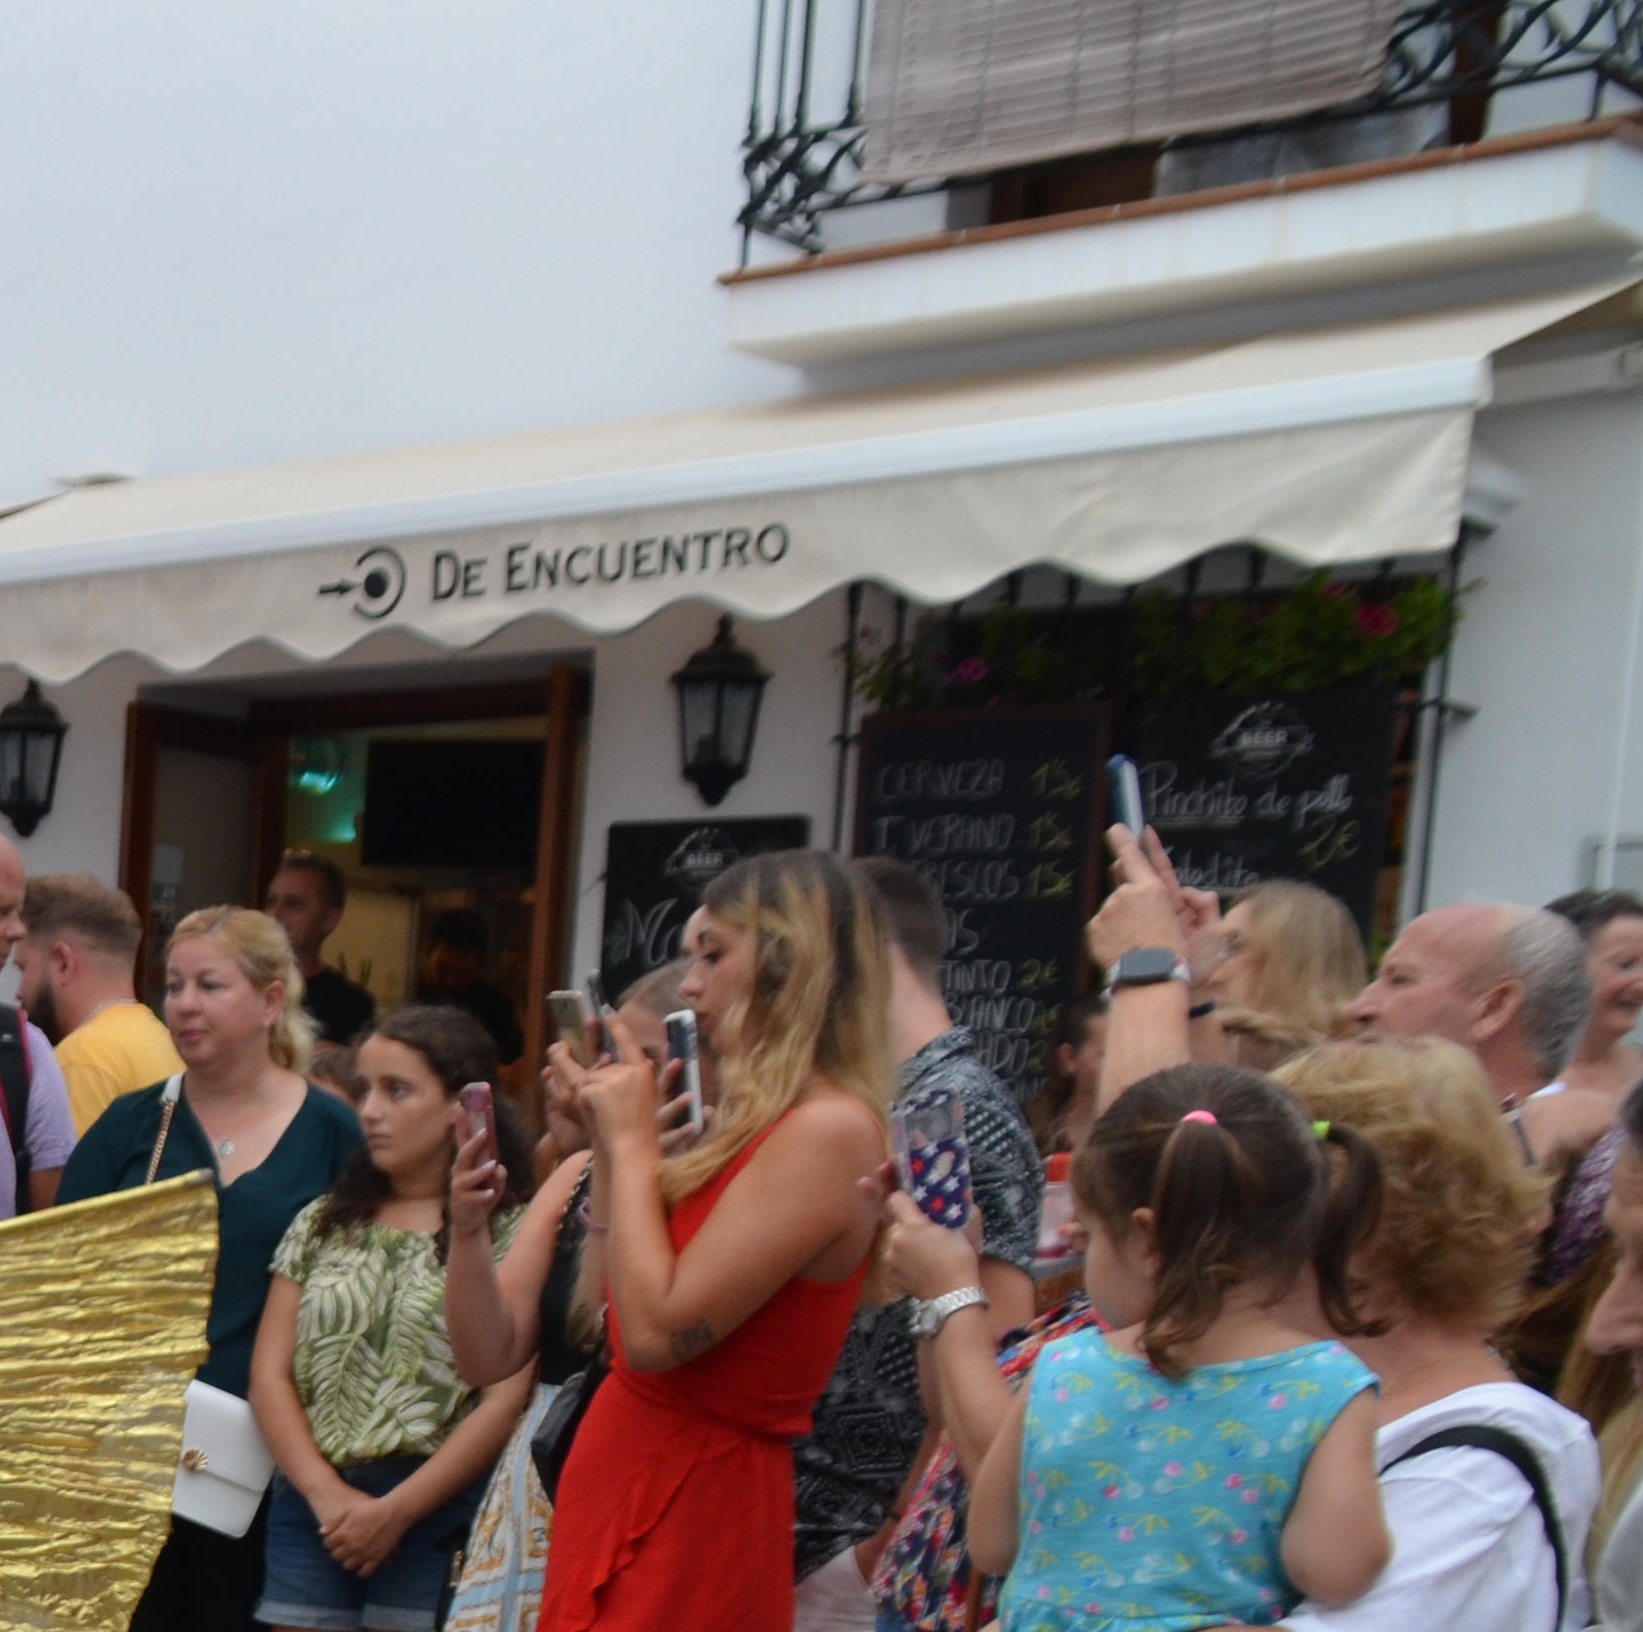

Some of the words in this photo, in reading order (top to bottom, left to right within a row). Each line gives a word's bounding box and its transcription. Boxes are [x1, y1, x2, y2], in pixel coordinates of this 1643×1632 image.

[431, 548, 488, 601] DE
[504, 521, 792, 592] ENCUENTRO
[1240, 728, 1288, 747] BEER
[871, 758, 1006, 800] CERVEZA
[1140, 759, 1247, 823] Pinchito
[1255, 780, 1292, 818] de
[909, 811, 1016, 855] VERANO
[941, 958, 1012, 996] TINTO
